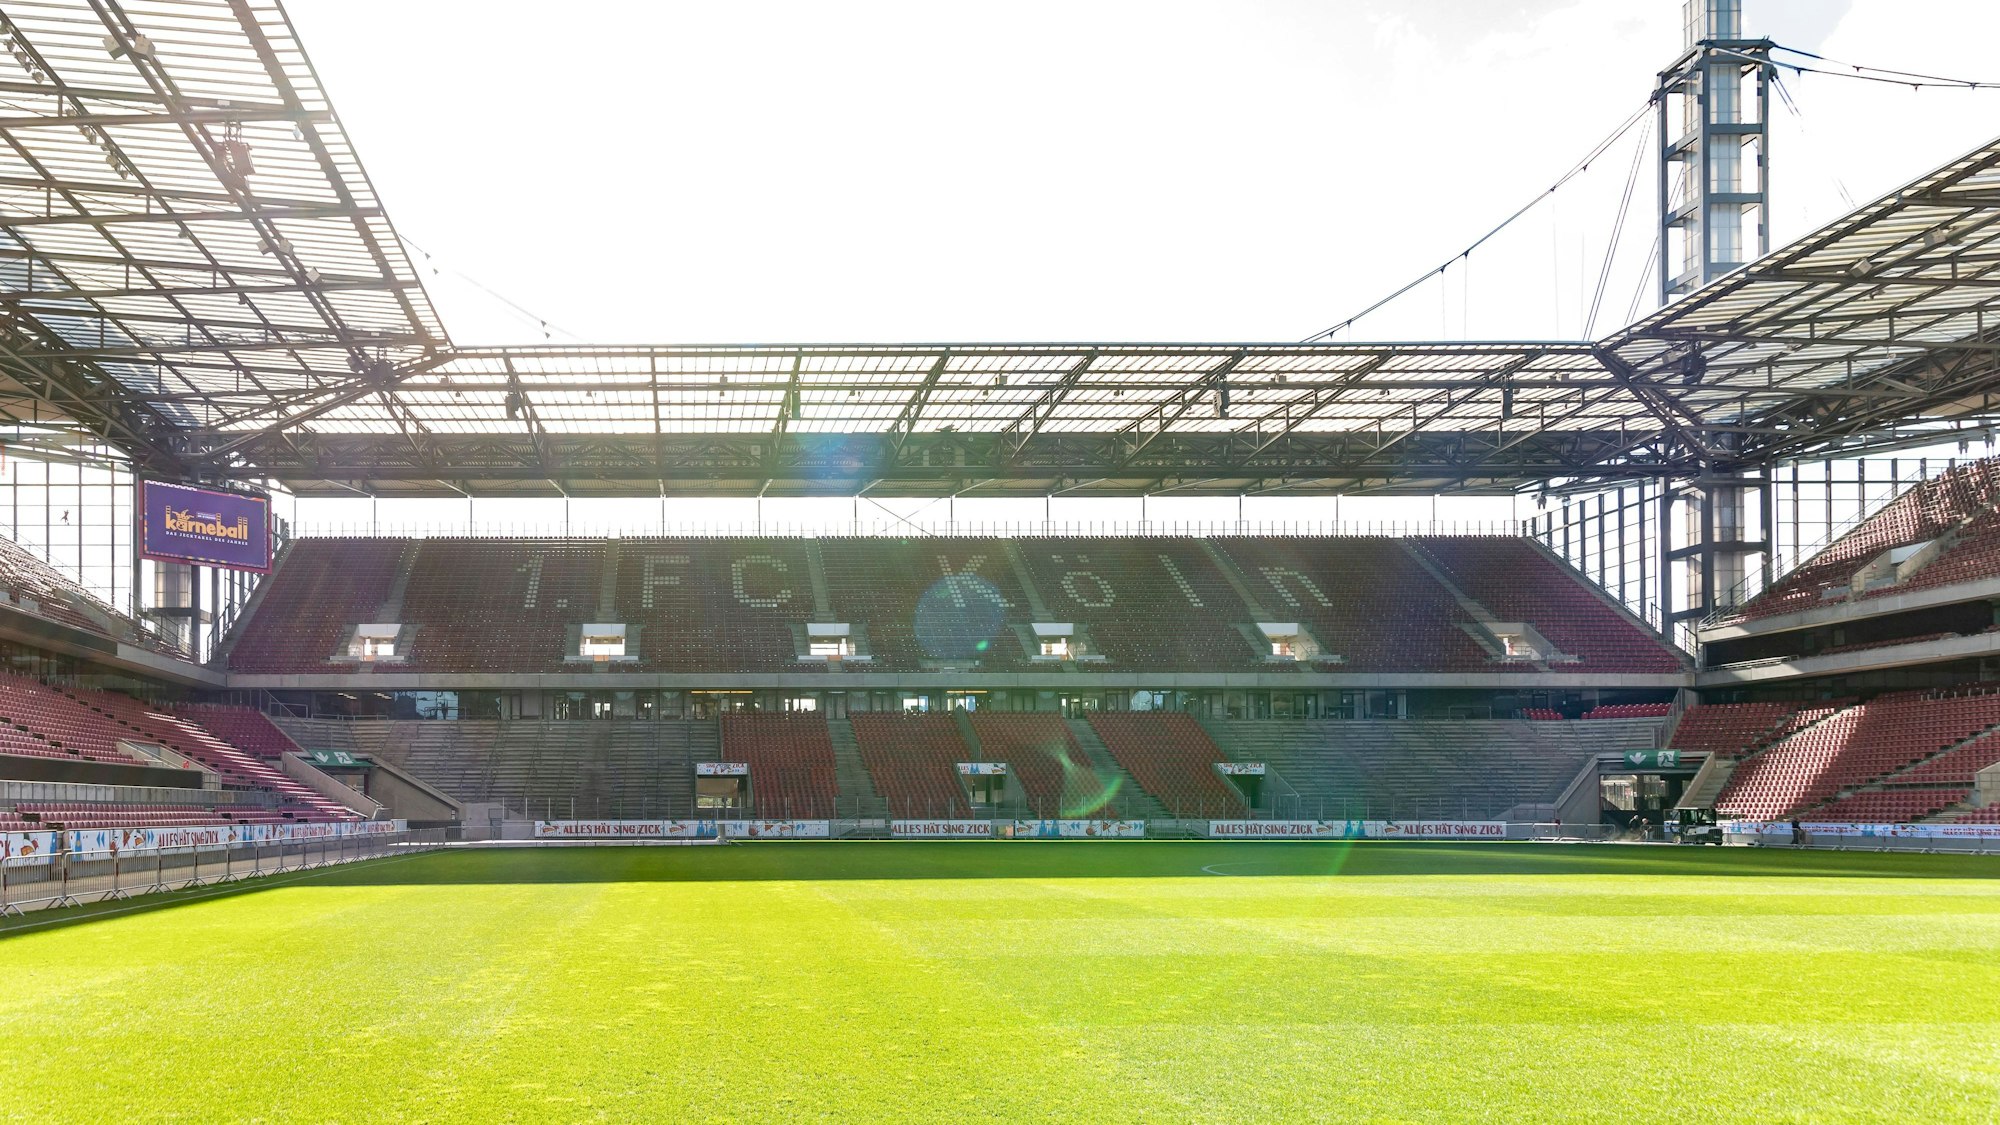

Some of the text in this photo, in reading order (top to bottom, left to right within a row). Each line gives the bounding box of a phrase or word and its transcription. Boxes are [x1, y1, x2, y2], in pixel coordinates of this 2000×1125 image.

[165, 505, 248, 540] karneball
[516, 554, 1333, 608] 1. FC Köln
[563, 822, 661, 834] ALLES HÄT SING ZICK
[893, 822, 990, 834] ALLES HÄT SING ZICK
[1215, 822, 1313, 835] ALLES HÄT SING ZICK
[1403, 822, 1503, 835] ALLES HÄT SING ZICK
